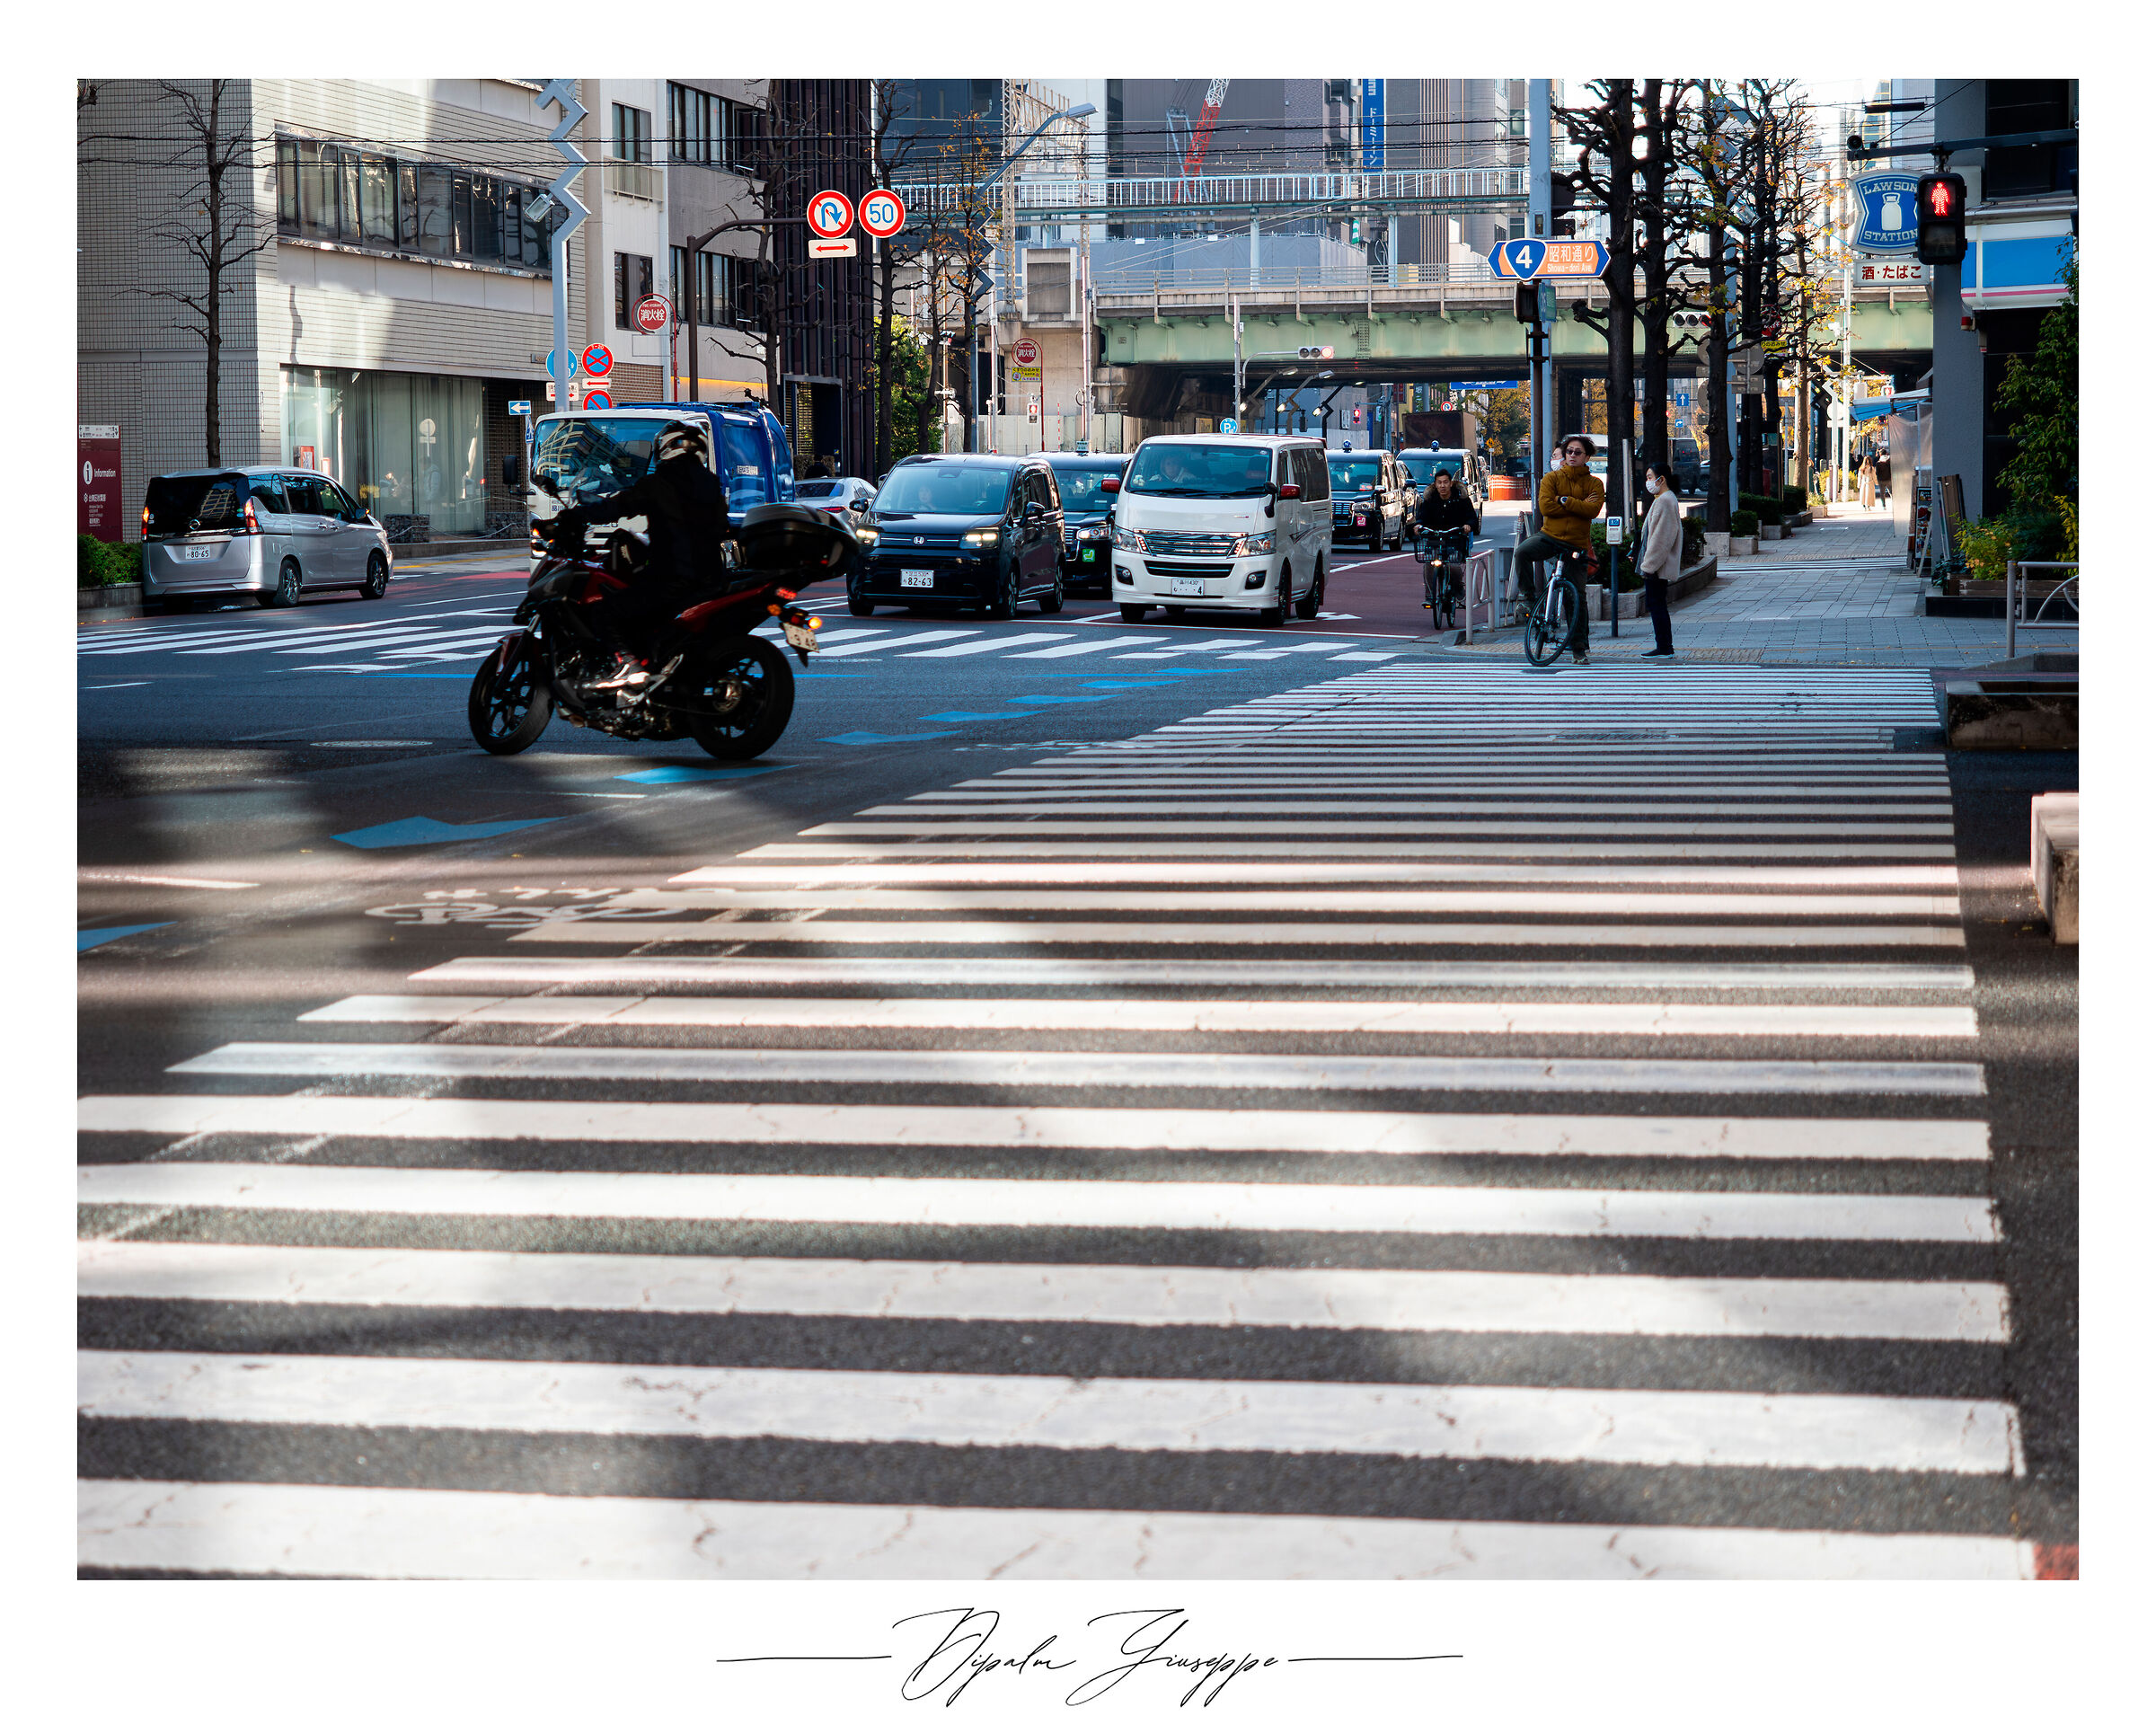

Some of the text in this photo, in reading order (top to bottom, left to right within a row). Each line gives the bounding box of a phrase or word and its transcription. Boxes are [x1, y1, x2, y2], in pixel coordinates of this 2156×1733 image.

[1369, 107, 1377, 165] ドーミーイン
[1862, 181, 1918, 195] LAWSON
[869, 203, 894, 224] 50
[1863, 228, 1918, 242] STATION
[1515, 245, 1533, 269] 4
[1549, 245, 1594, 263] 昭和通り
[641, 309, 665, 321] 消火栓
[1018, 349, 1035, 358] 消火栓
[93, 468, 117, 478] Information
[907, 577, 932, 587] 82-63
